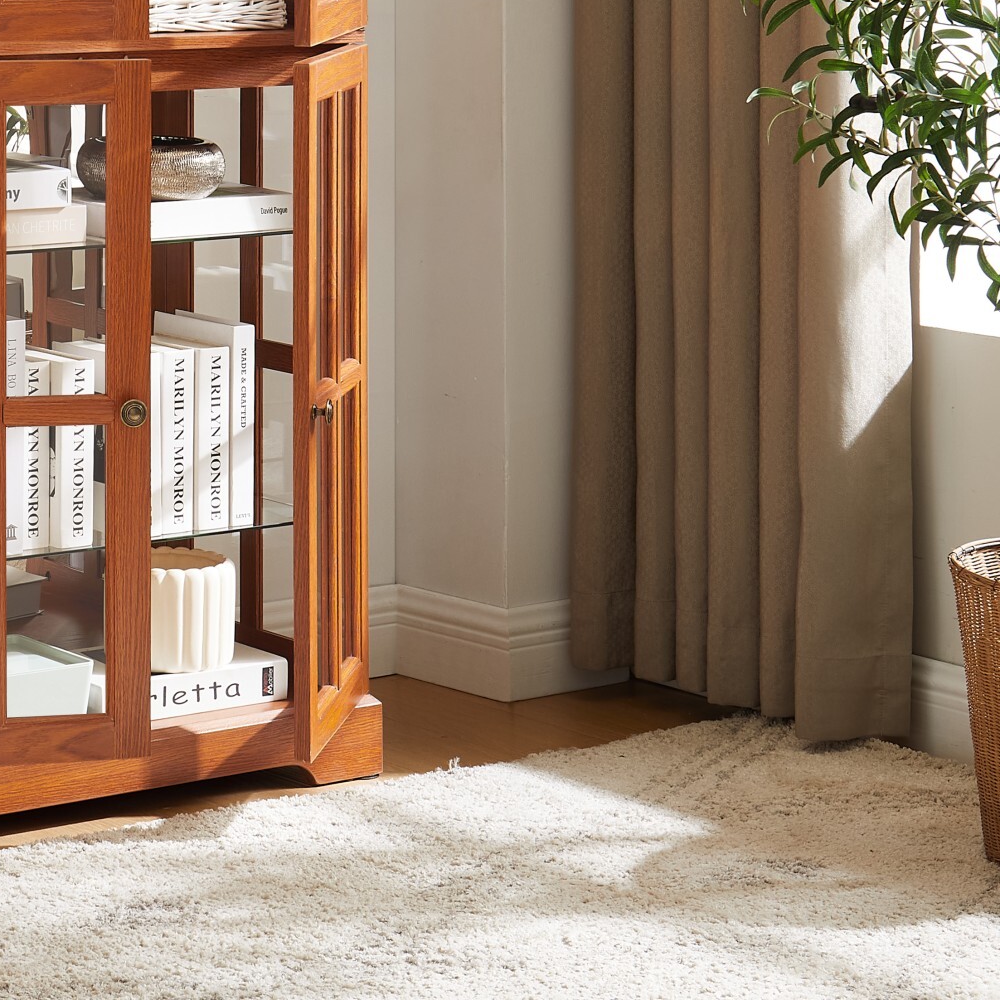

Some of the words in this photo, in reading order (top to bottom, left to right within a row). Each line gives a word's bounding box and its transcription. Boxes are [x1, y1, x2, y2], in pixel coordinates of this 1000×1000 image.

[260, 207, 273, 215] David
[273, 206, 288, 216] Pogue
[7, 339, 17, 367] LINA
[7, 374, 17, 389] BO
[173, 358, 185, 441] MARILYN
[210, 355, 221, 437] MARILYN
[28, 458, 40, 538] MONROE
[72, 457, 84, 538] MONROE
[173, 447, 184, 525] MONROE
[210, 443, 221, 521] MONROE
